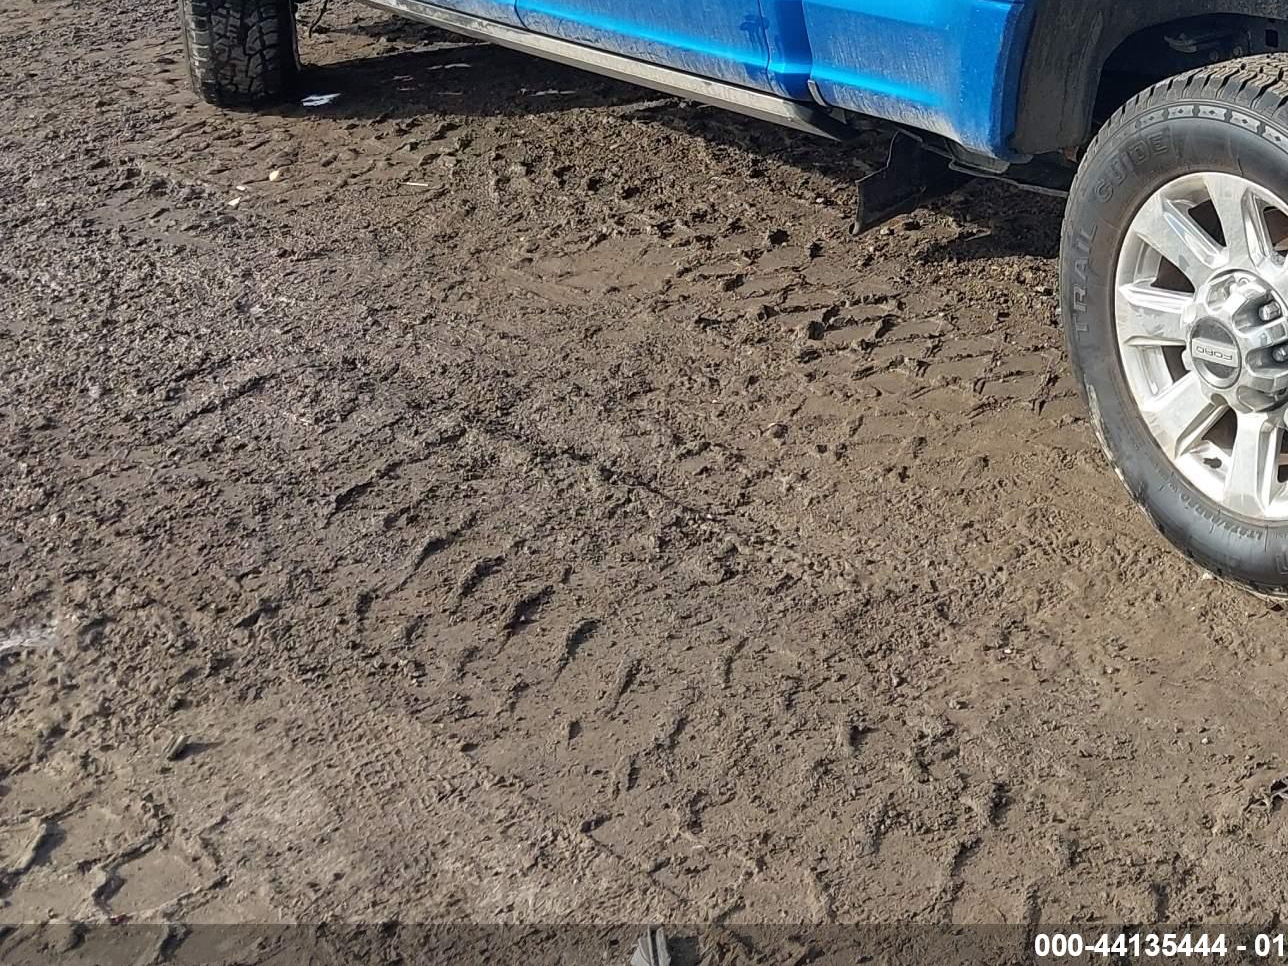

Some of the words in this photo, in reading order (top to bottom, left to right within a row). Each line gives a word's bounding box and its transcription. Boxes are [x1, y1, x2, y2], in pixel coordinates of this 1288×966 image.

[1073, 223, 1098, 342] TRAIL
[1095, 129, 1168, 203] GUIDE
[1196, 346, 1233, 361] FORD
